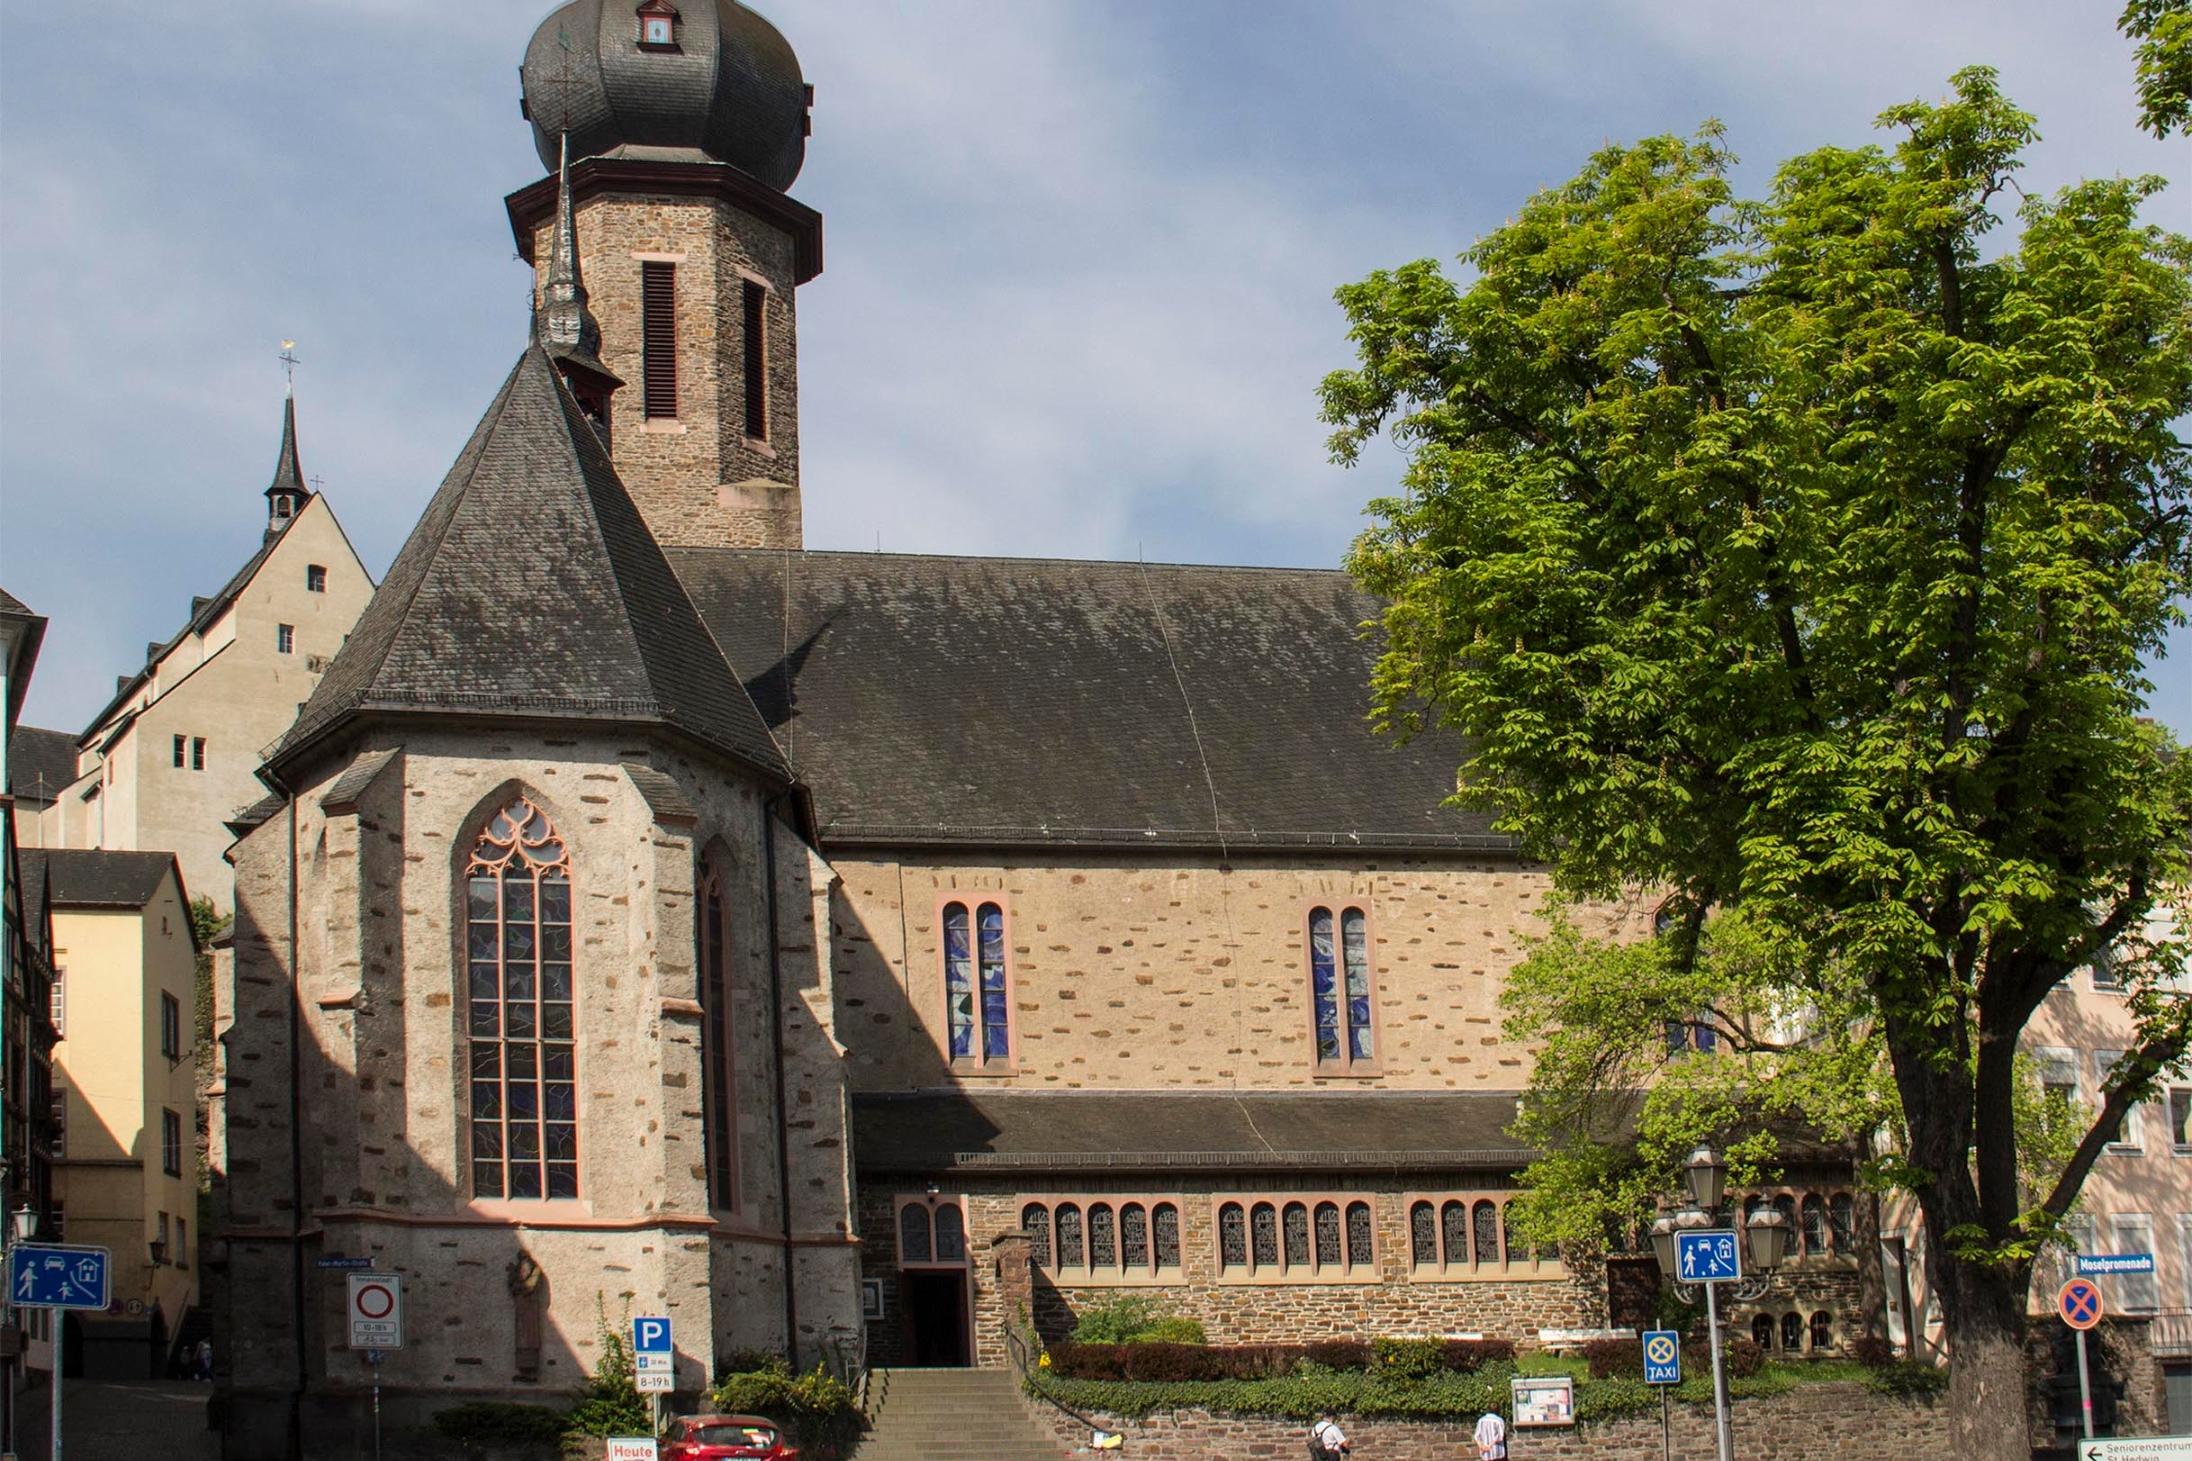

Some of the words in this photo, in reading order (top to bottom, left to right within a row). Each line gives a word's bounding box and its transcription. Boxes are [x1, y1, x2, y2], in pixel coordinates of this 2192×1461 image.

[2080, 1257, 2151, 1272] Moselpromenade
[642, 1322, 663, 1348] P
[1649, 1366, 1676, 1379] TAXI
[641, 1377, 662, 1387] 8-19
[664, 1377, 670, 1387] h
[614, 1445, 652, 1457] Heute
